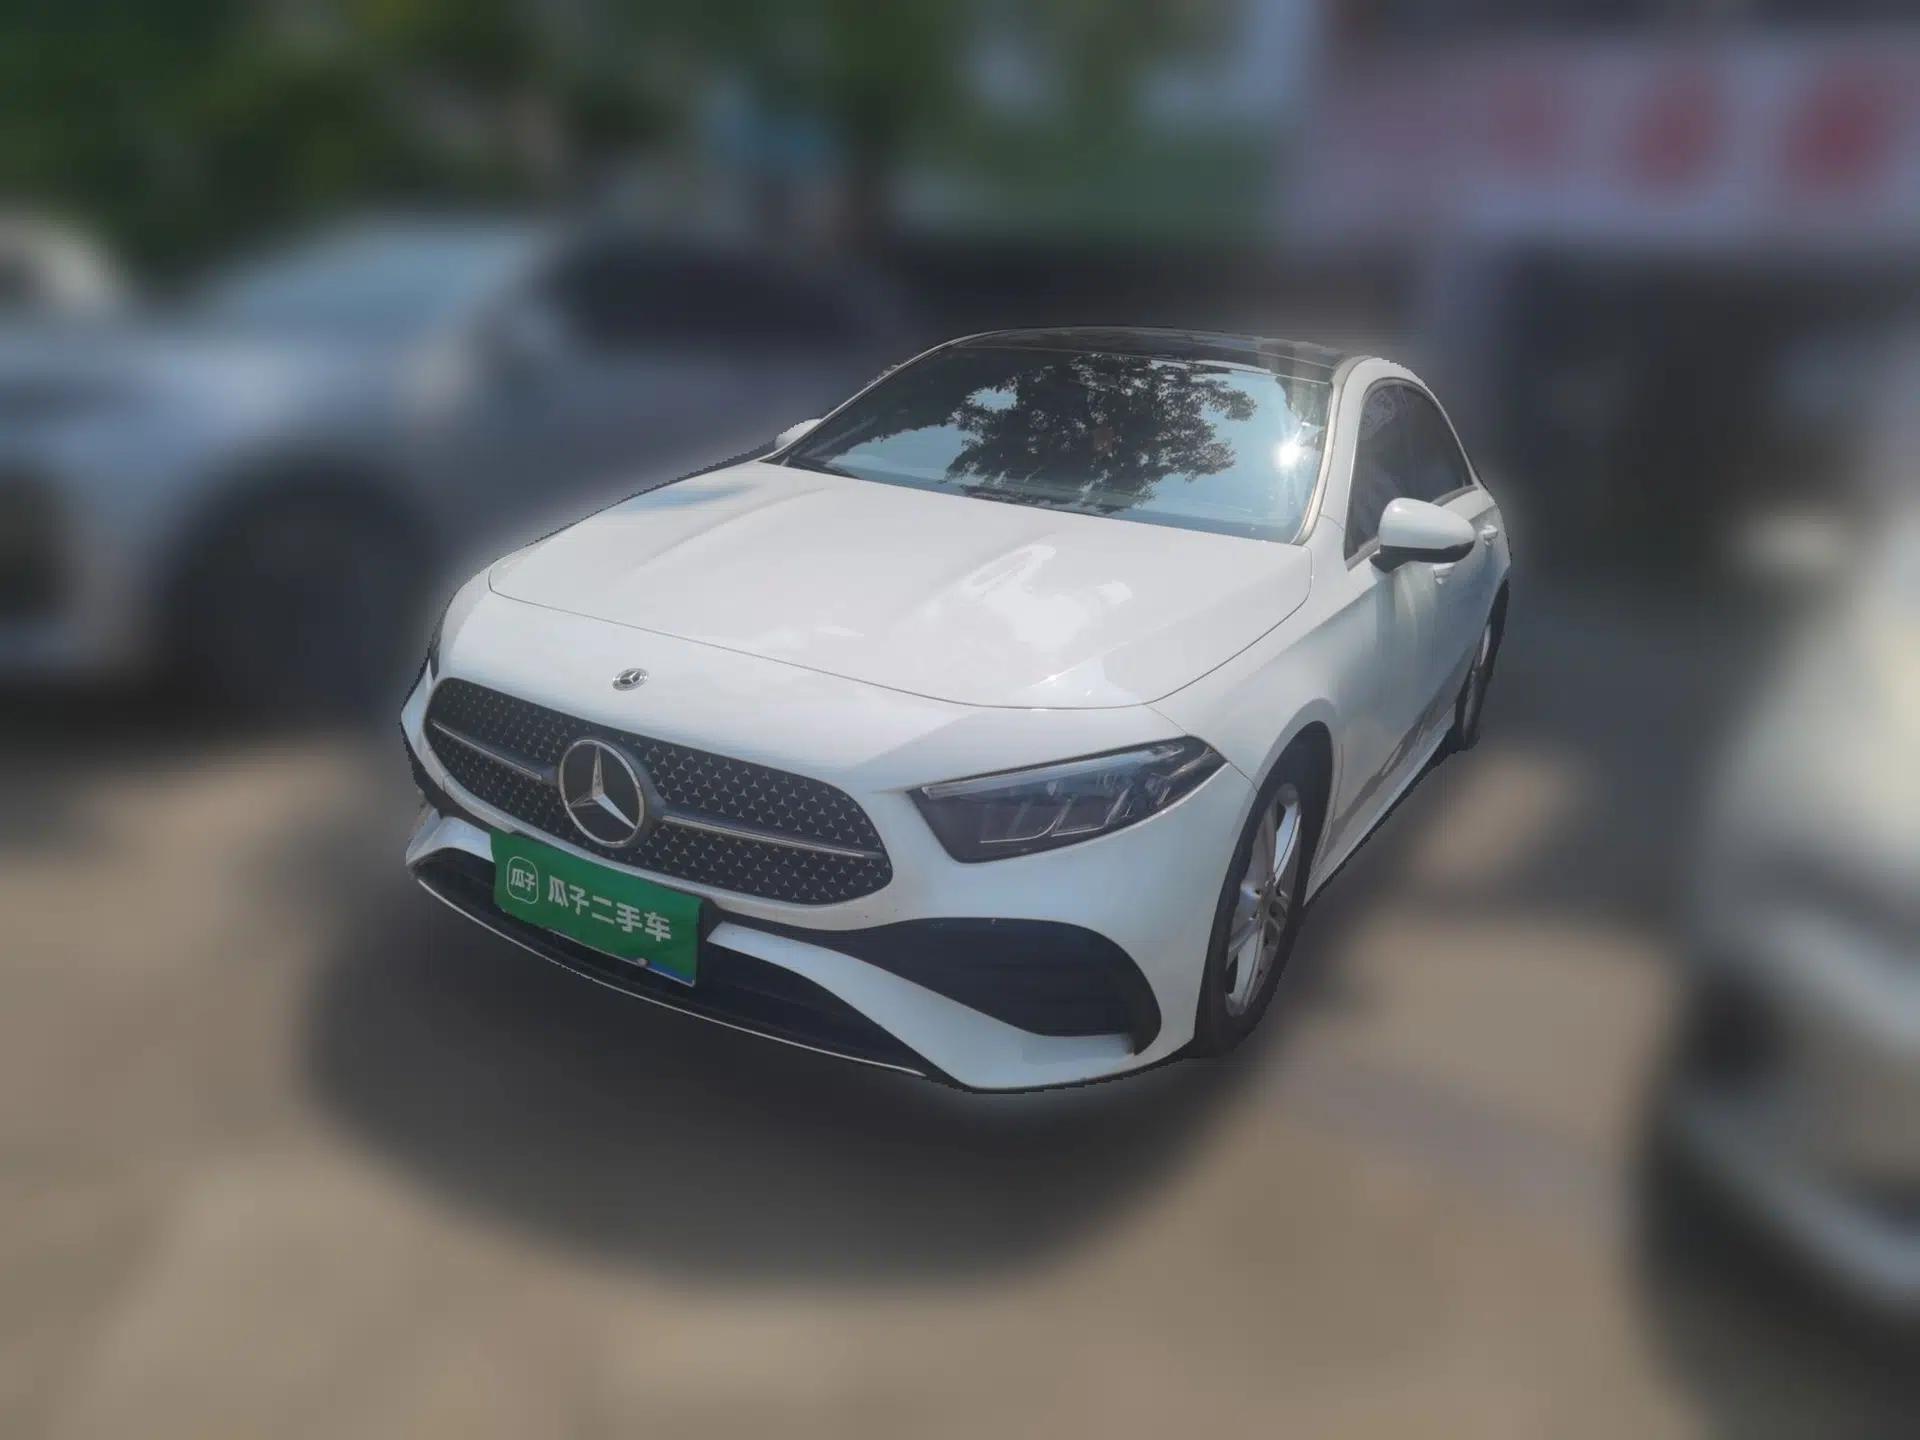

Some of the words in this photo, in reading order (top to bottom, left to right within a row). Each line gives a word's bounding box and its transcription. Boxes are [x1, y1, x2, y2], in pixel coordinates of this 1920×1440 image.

[510, 868, 536, 892] 瓜子
[548, 875, 672, 942] 瓜子二手车
